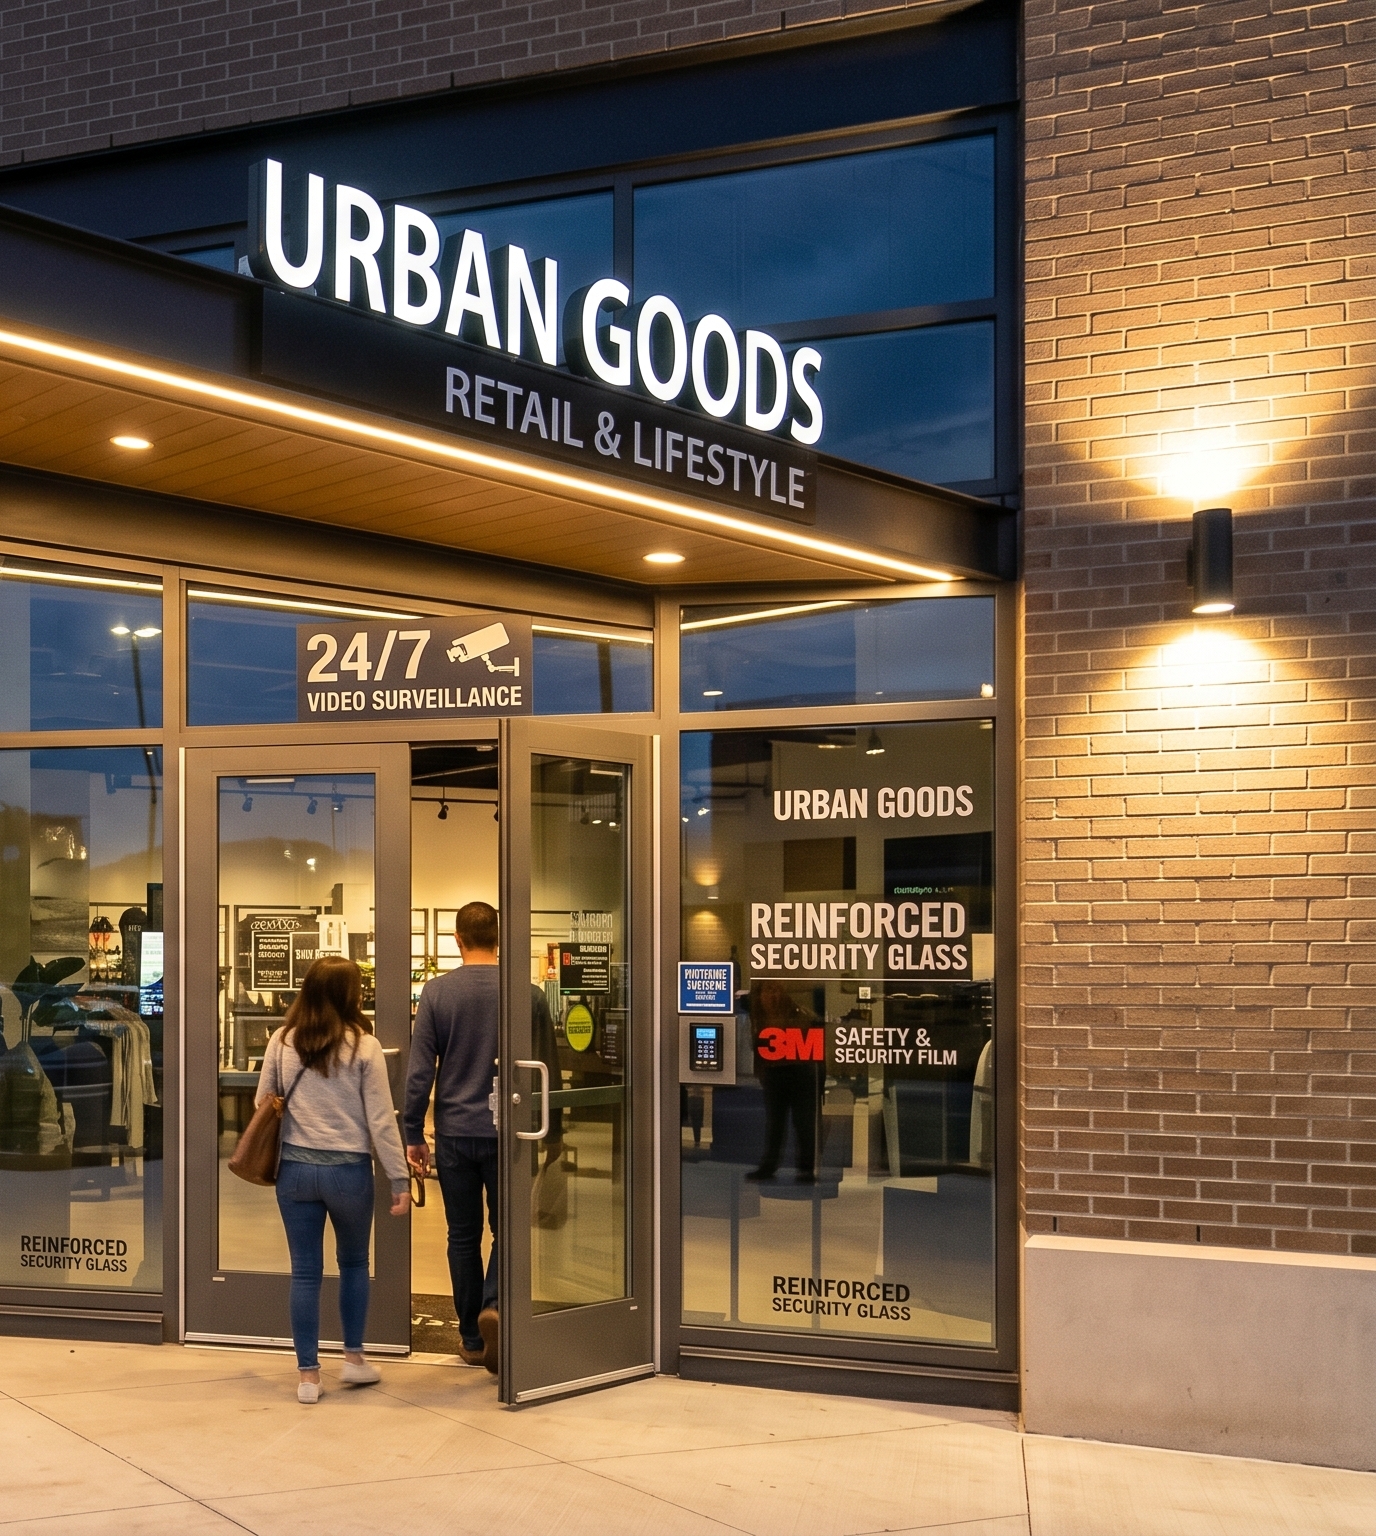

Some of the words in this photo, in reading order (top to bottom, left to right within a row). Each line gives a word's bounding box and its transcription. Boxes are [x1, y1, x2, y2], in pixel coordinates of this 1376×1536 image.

[265, 158, 557, 367] URBAN
[581, 277, 824, 446] GOODS
[445, 365, 584, 449] RETAIL
[594, 411, 622, 460] &
[633, 421, 806, 510] LIFESTYLE
[306, 629, 431, 683] 24/7
[307, 690, 366, 712] VIDEO
[372, 685, 523, 711] SURVEILLANCE
[773, 788, 868, 821] URBAN
[877, 785, 974, 818] GOODS
[750, 901, 966, 939] REINFORCED
[750, 943, 880, 970] SECURITY
[888, 944, 968, 971] GLASS
[757, 1027, 824, 1061] 3M
[834, 1026, 910, 1047] SAFETY
[915, 1027, 931, 1047] &
[834, 1047, 914, 1065] SECURITY
[917, 1049, 958, 1066] FILM
[20, 1235, 128, 1256] REINFORCED
[20, 1254, 82, 1270] SECURITY
[86, 1257, 128, 1272] GLASS
[772, 1275, 911, 1303] REINFORCED
[772, 1297, 852, 1317] SECURITY
[857, 1303, 911, 1321] GLASS
